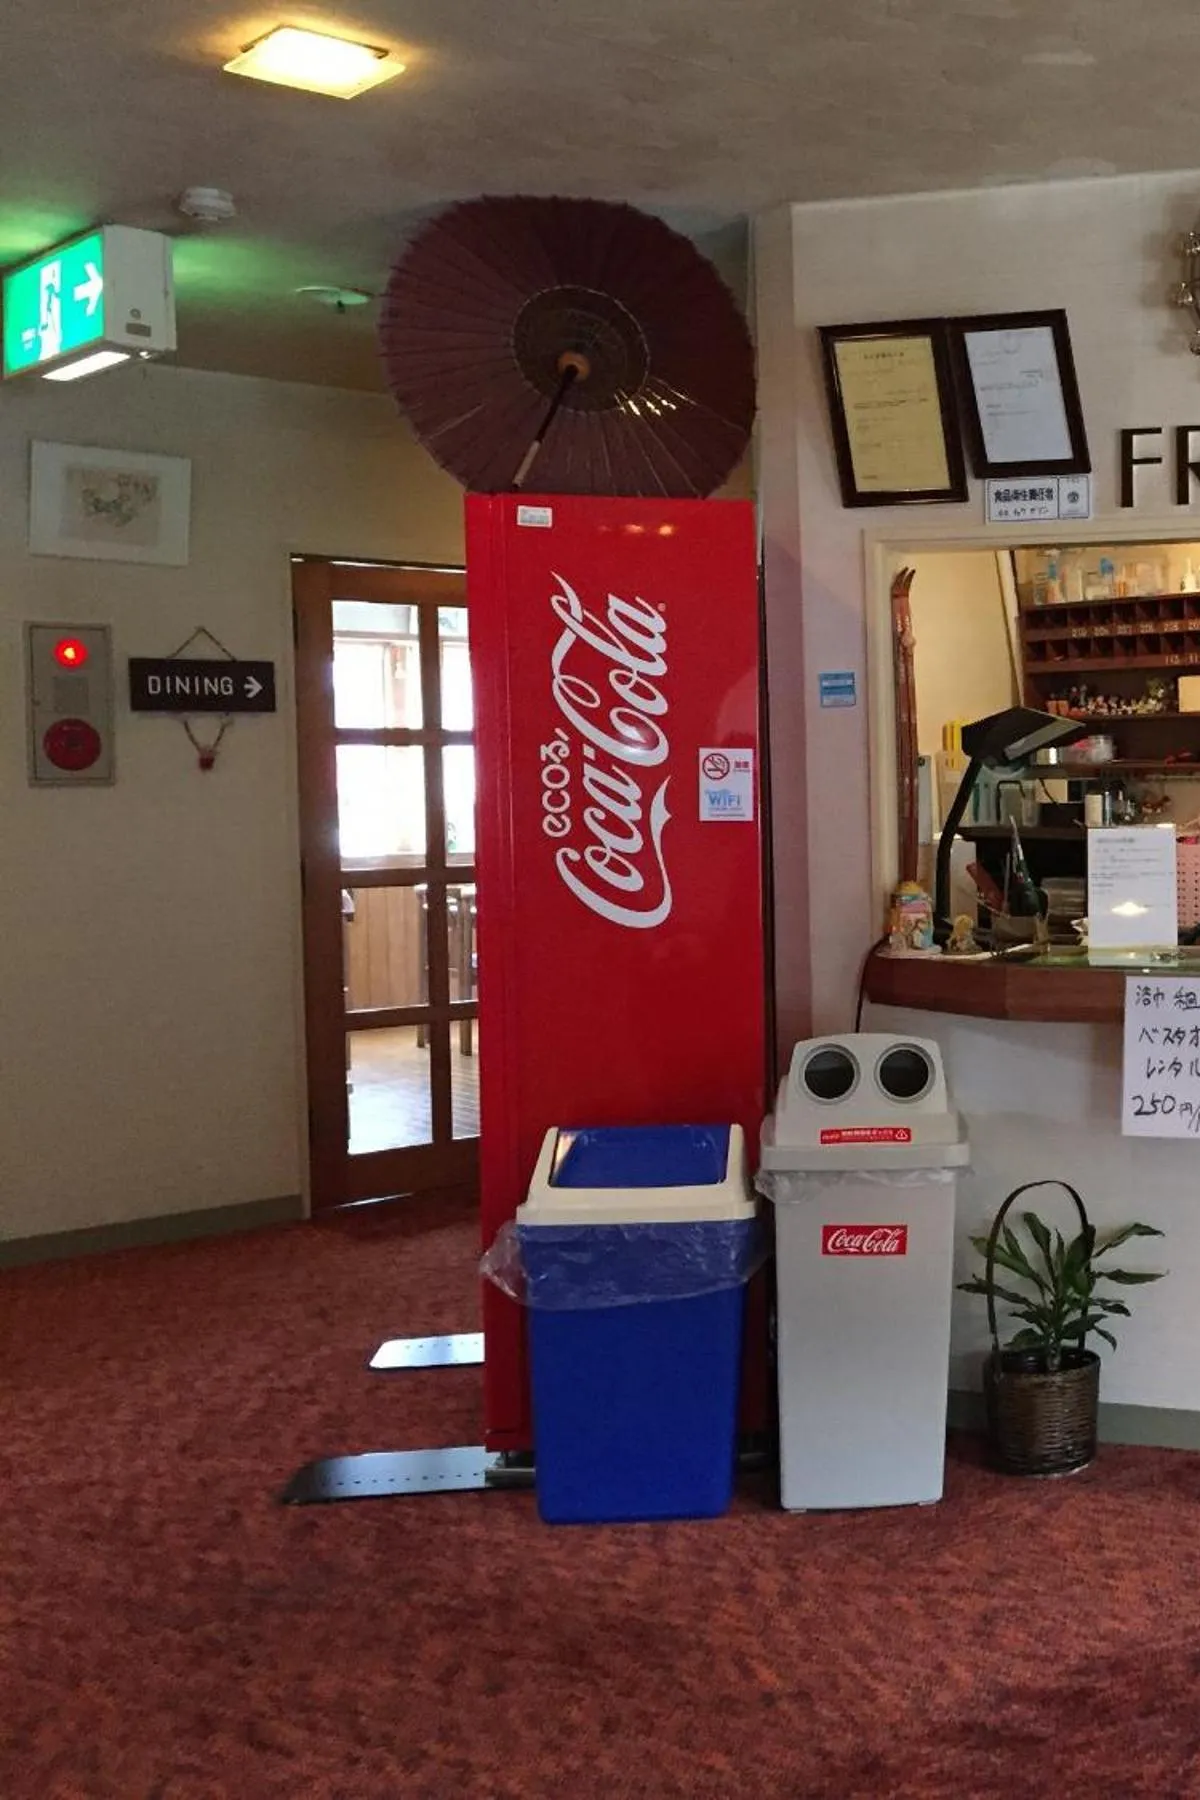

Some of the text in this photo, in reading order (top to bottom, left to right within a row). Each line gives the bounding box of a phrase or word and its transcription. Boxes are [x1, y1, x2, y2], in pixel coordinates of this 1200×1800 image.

[148, 675, 234, 696] DINING
[551, 571, 672, 929] Coca-Cola
[827, 1228, 904, 1253] Coca-Cola
